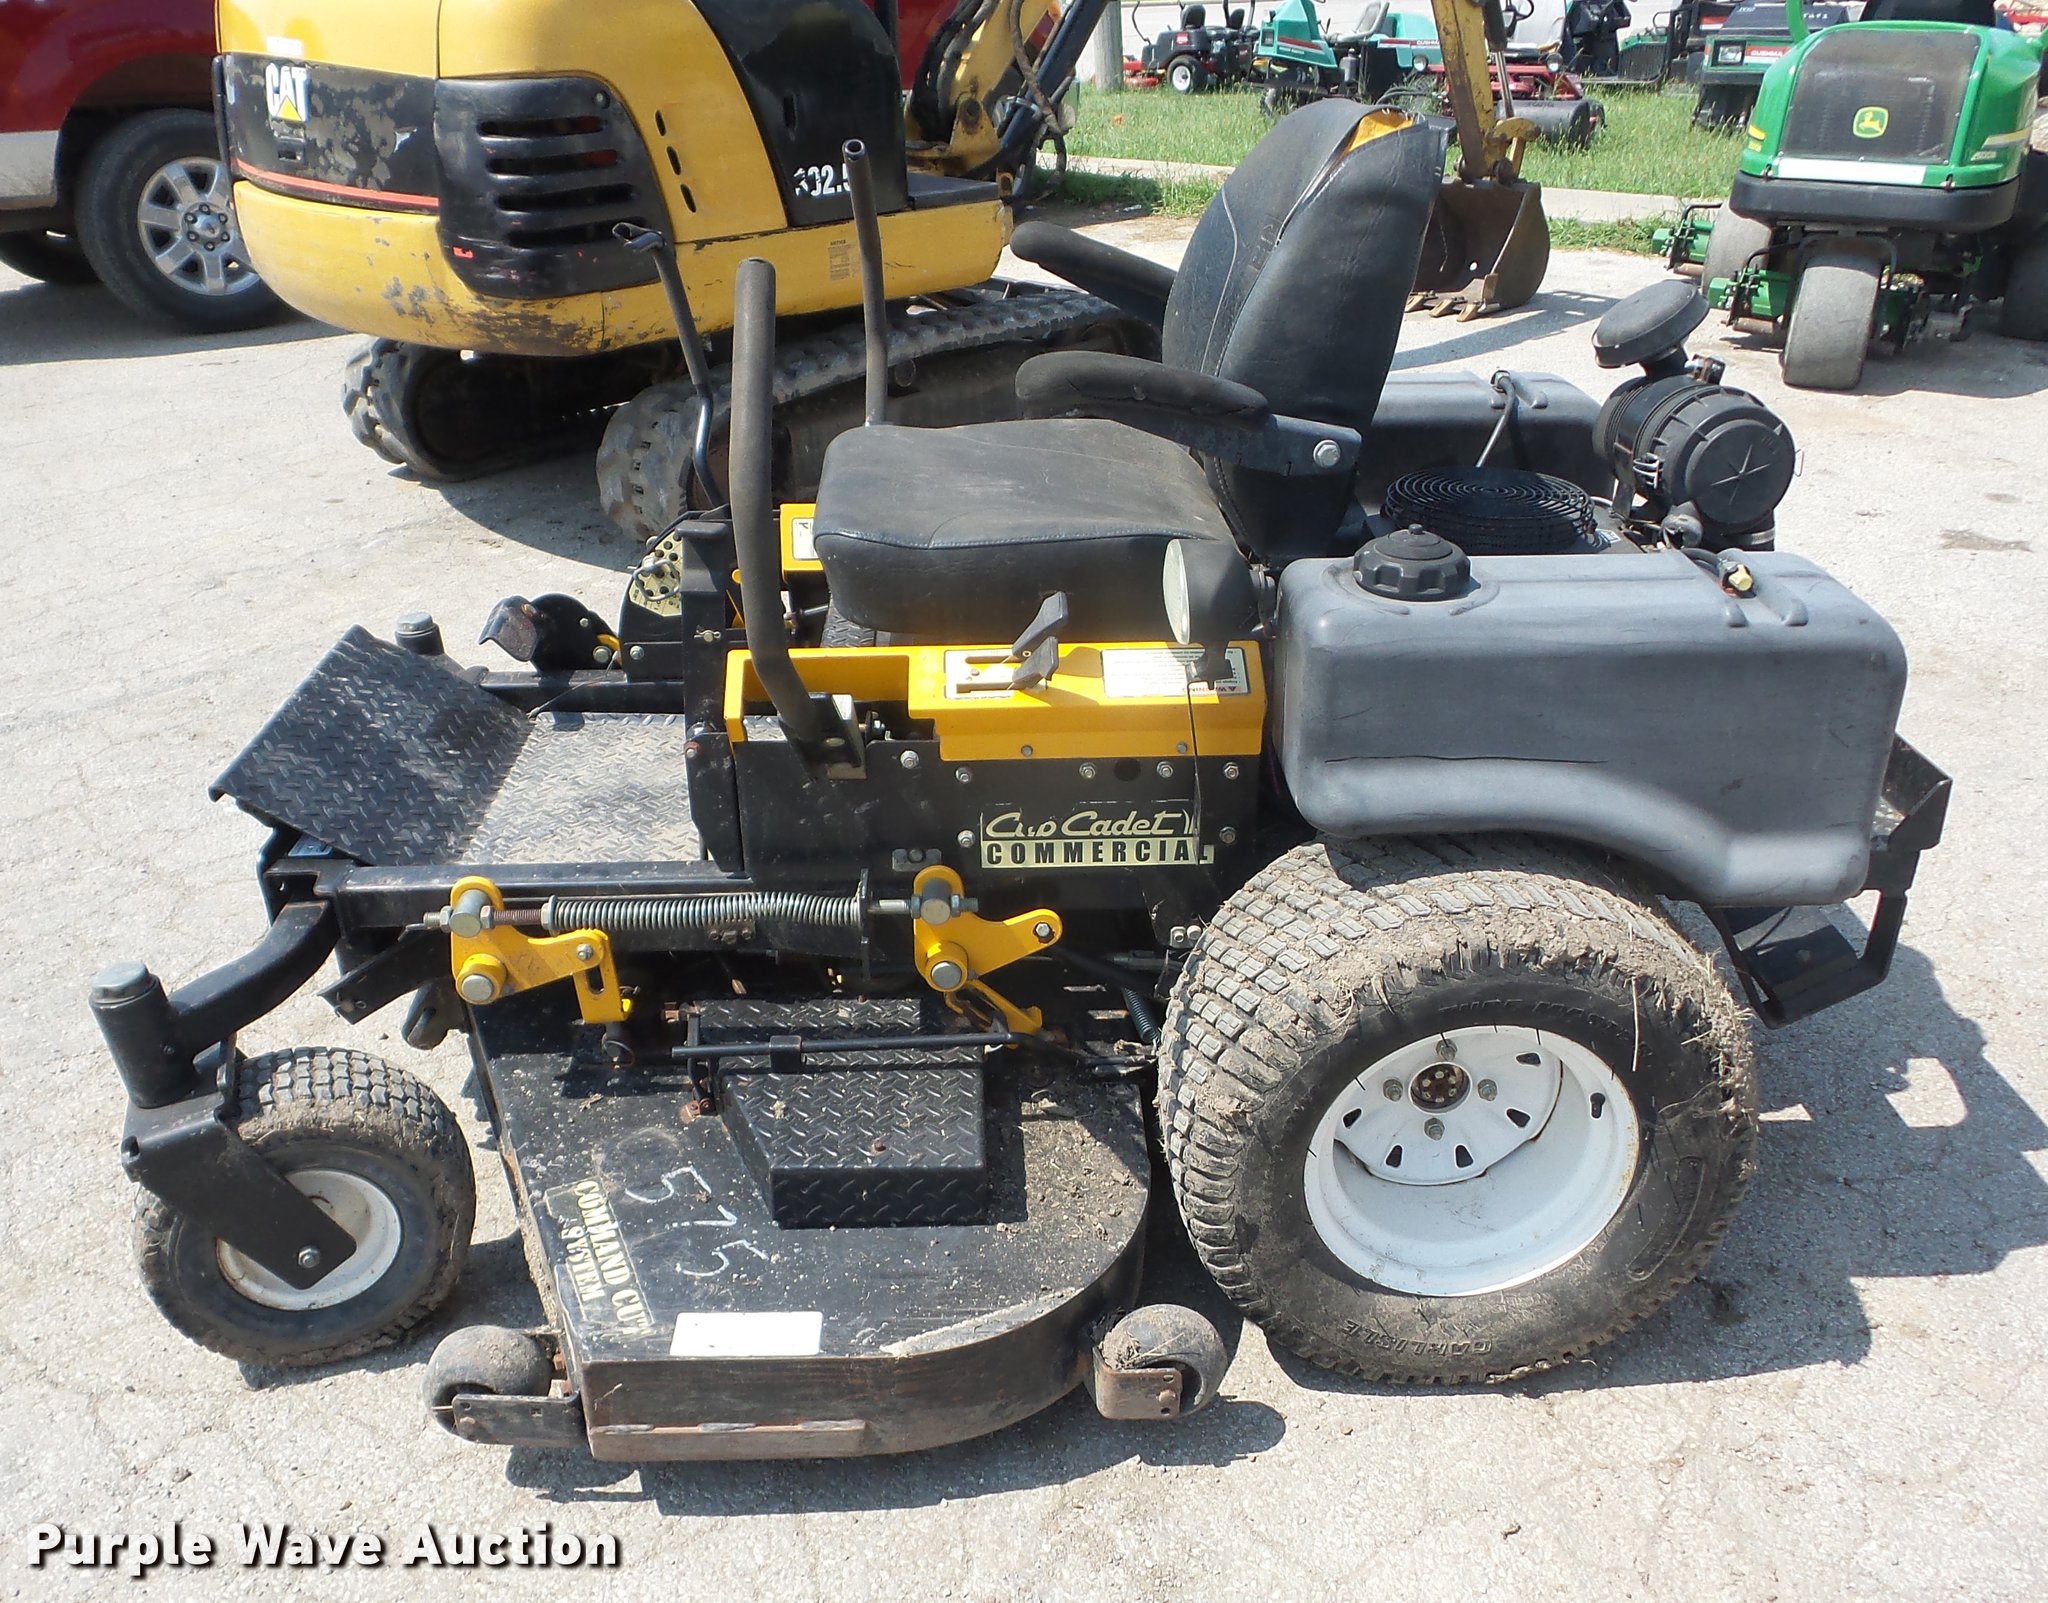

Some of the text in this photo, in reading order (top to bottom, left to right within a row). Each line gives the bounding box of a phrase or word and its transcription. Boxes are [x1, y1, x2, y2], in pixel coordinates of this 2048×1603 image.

[265, 62, 309, 122] CAT
[986, 839, 1208, 865] COMMERCIAL
[1061, 810, 1183, 836] Cadet
[574, 1179, 632, 1286] COMMAND
[561, 1225, 606, 1302] SYSTEM
